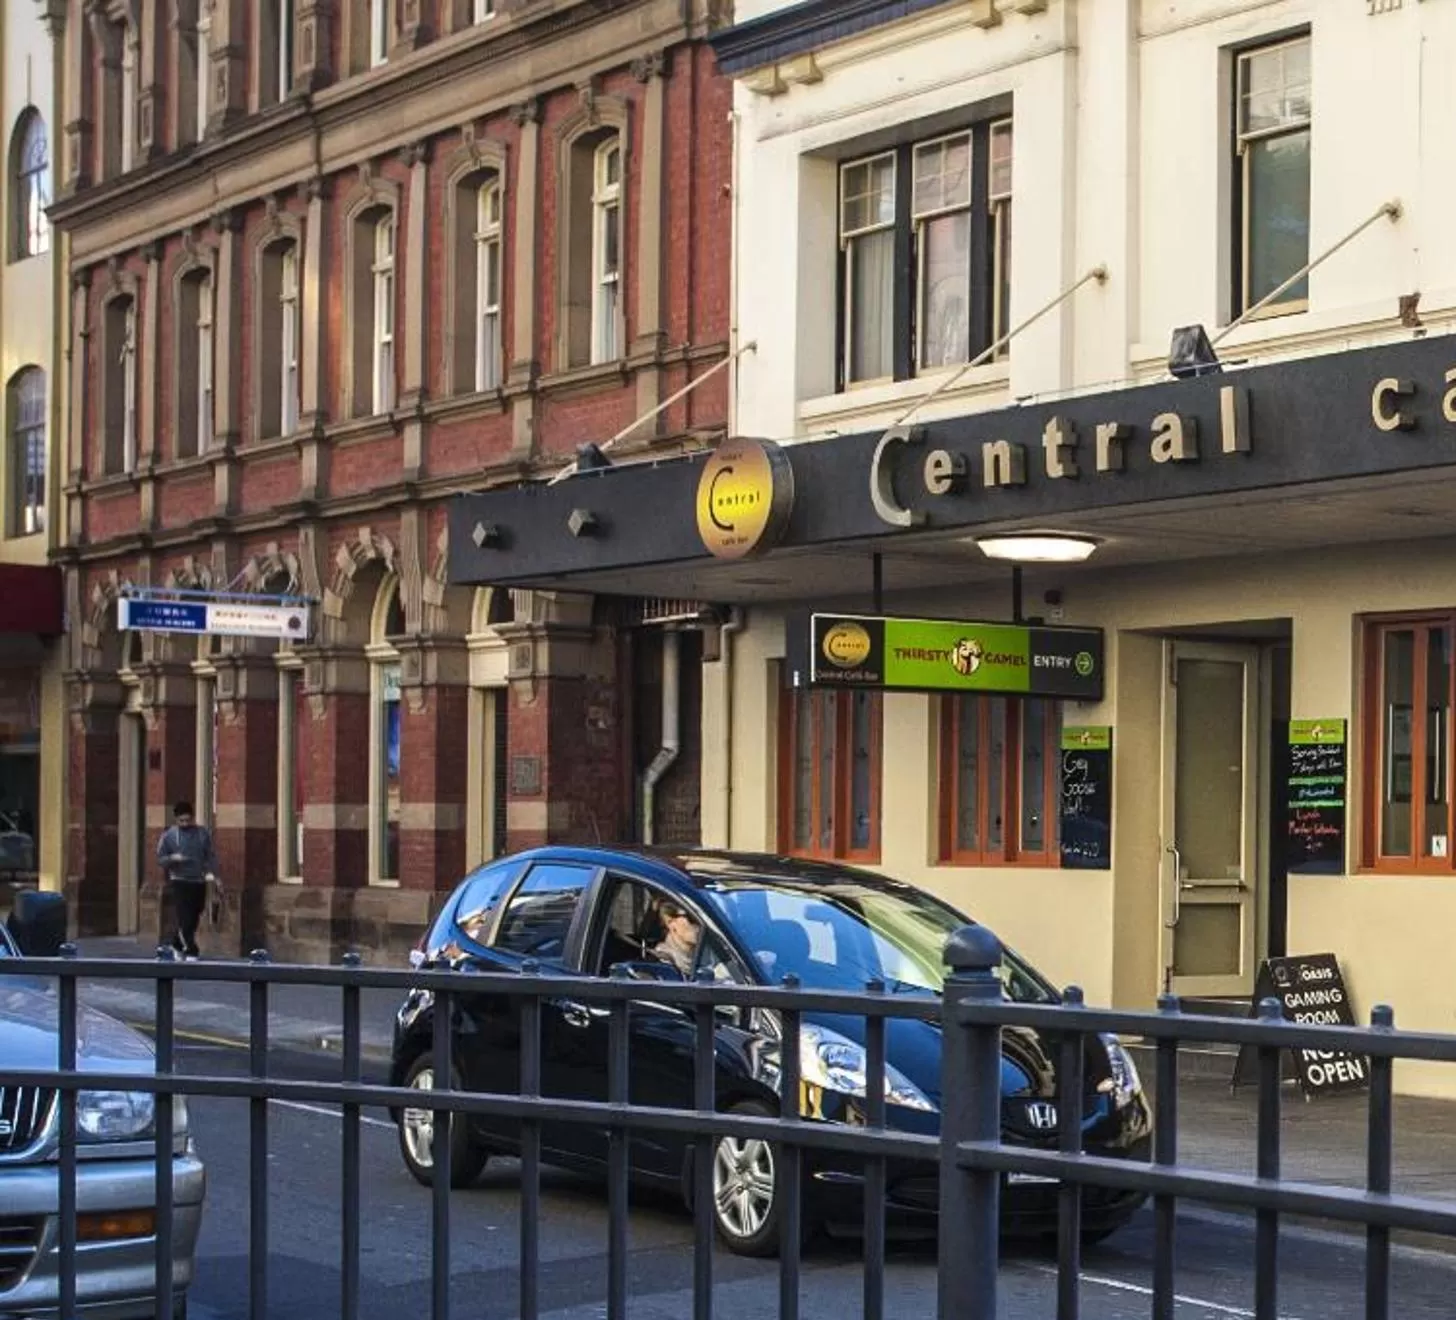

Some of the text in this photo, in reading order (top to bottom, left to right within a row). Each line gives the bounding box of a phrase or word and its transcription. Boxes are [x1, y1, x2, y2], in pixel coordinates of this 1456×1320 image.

[870, 385, 1250, 527] Central
[709, 466, 760, 531] Central
[894, 647, 1073, 669] THIRSTY CAMEL ENTRY
[1302, 967, 1333, 981] OASIS
[1284, 988, 1343, 1008] GAMING
[1294, 1009, 1341, 1025] ROOM
[1307, 1059, 1364, 1086] OPEN
